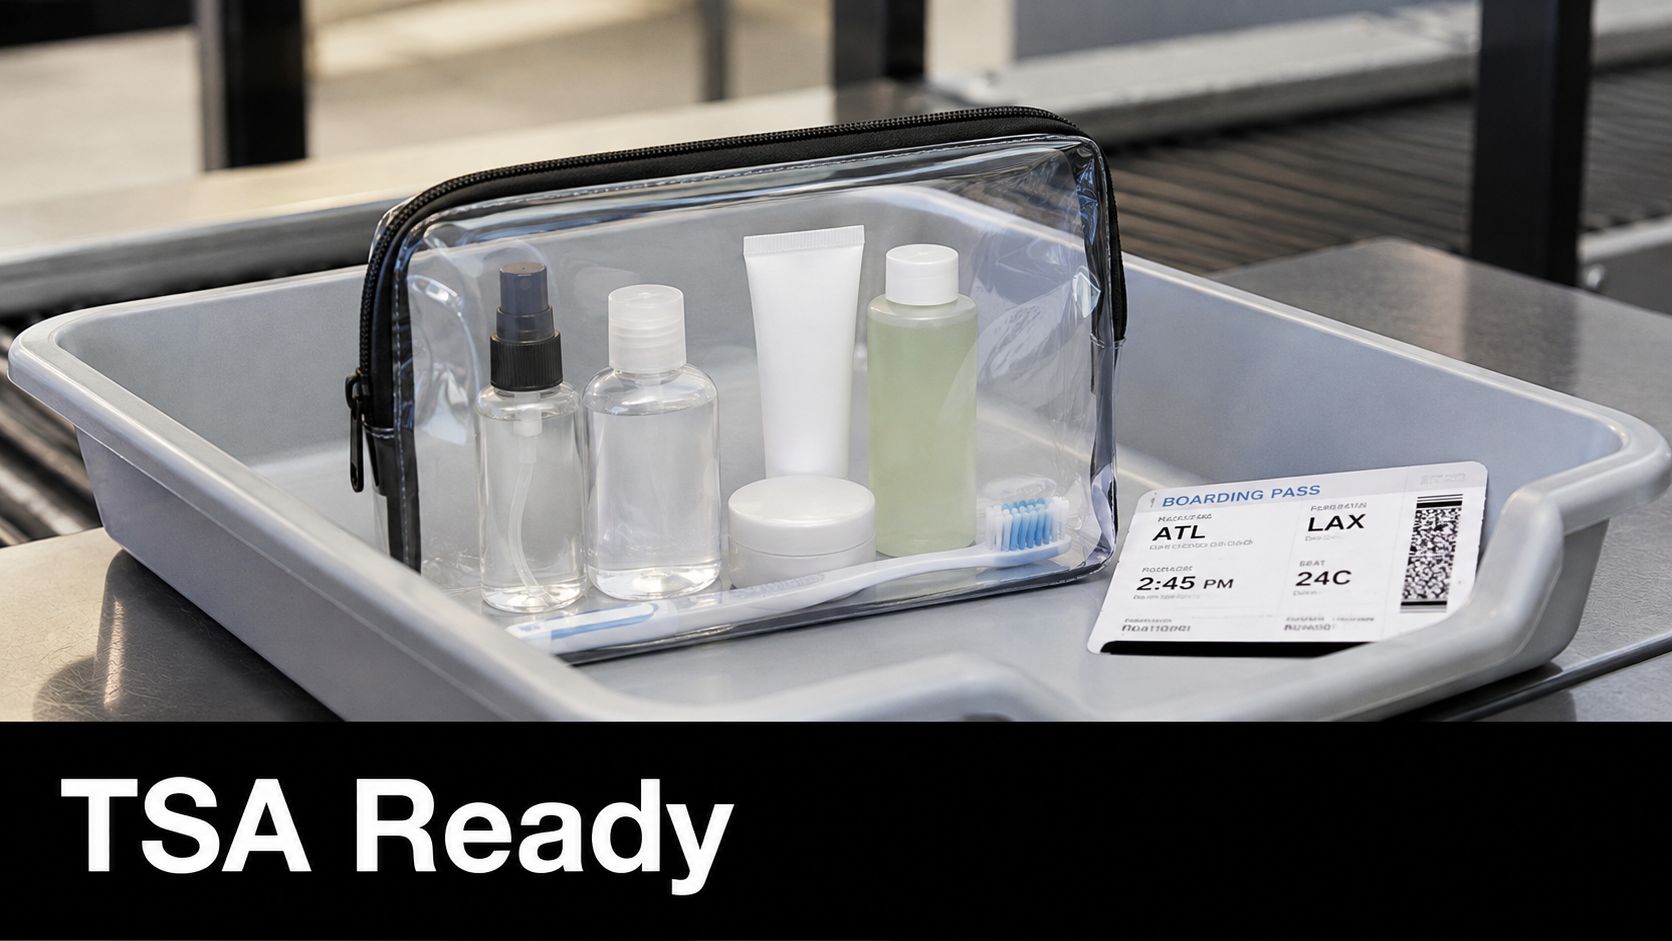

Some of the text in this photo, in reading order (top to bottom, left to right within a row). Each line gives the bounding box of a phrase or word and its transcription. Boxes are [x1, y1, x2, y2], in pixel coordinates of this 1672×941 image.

[1162, 484, 1321, 508] BOARDING PASS
[1307, 513, 1367, 532] LAX
[1152, 524, 1207, 542] ATL
[1136, 575, 1235, 591] 2:45 PM
[1295, 569, 1353, 587] 24C
